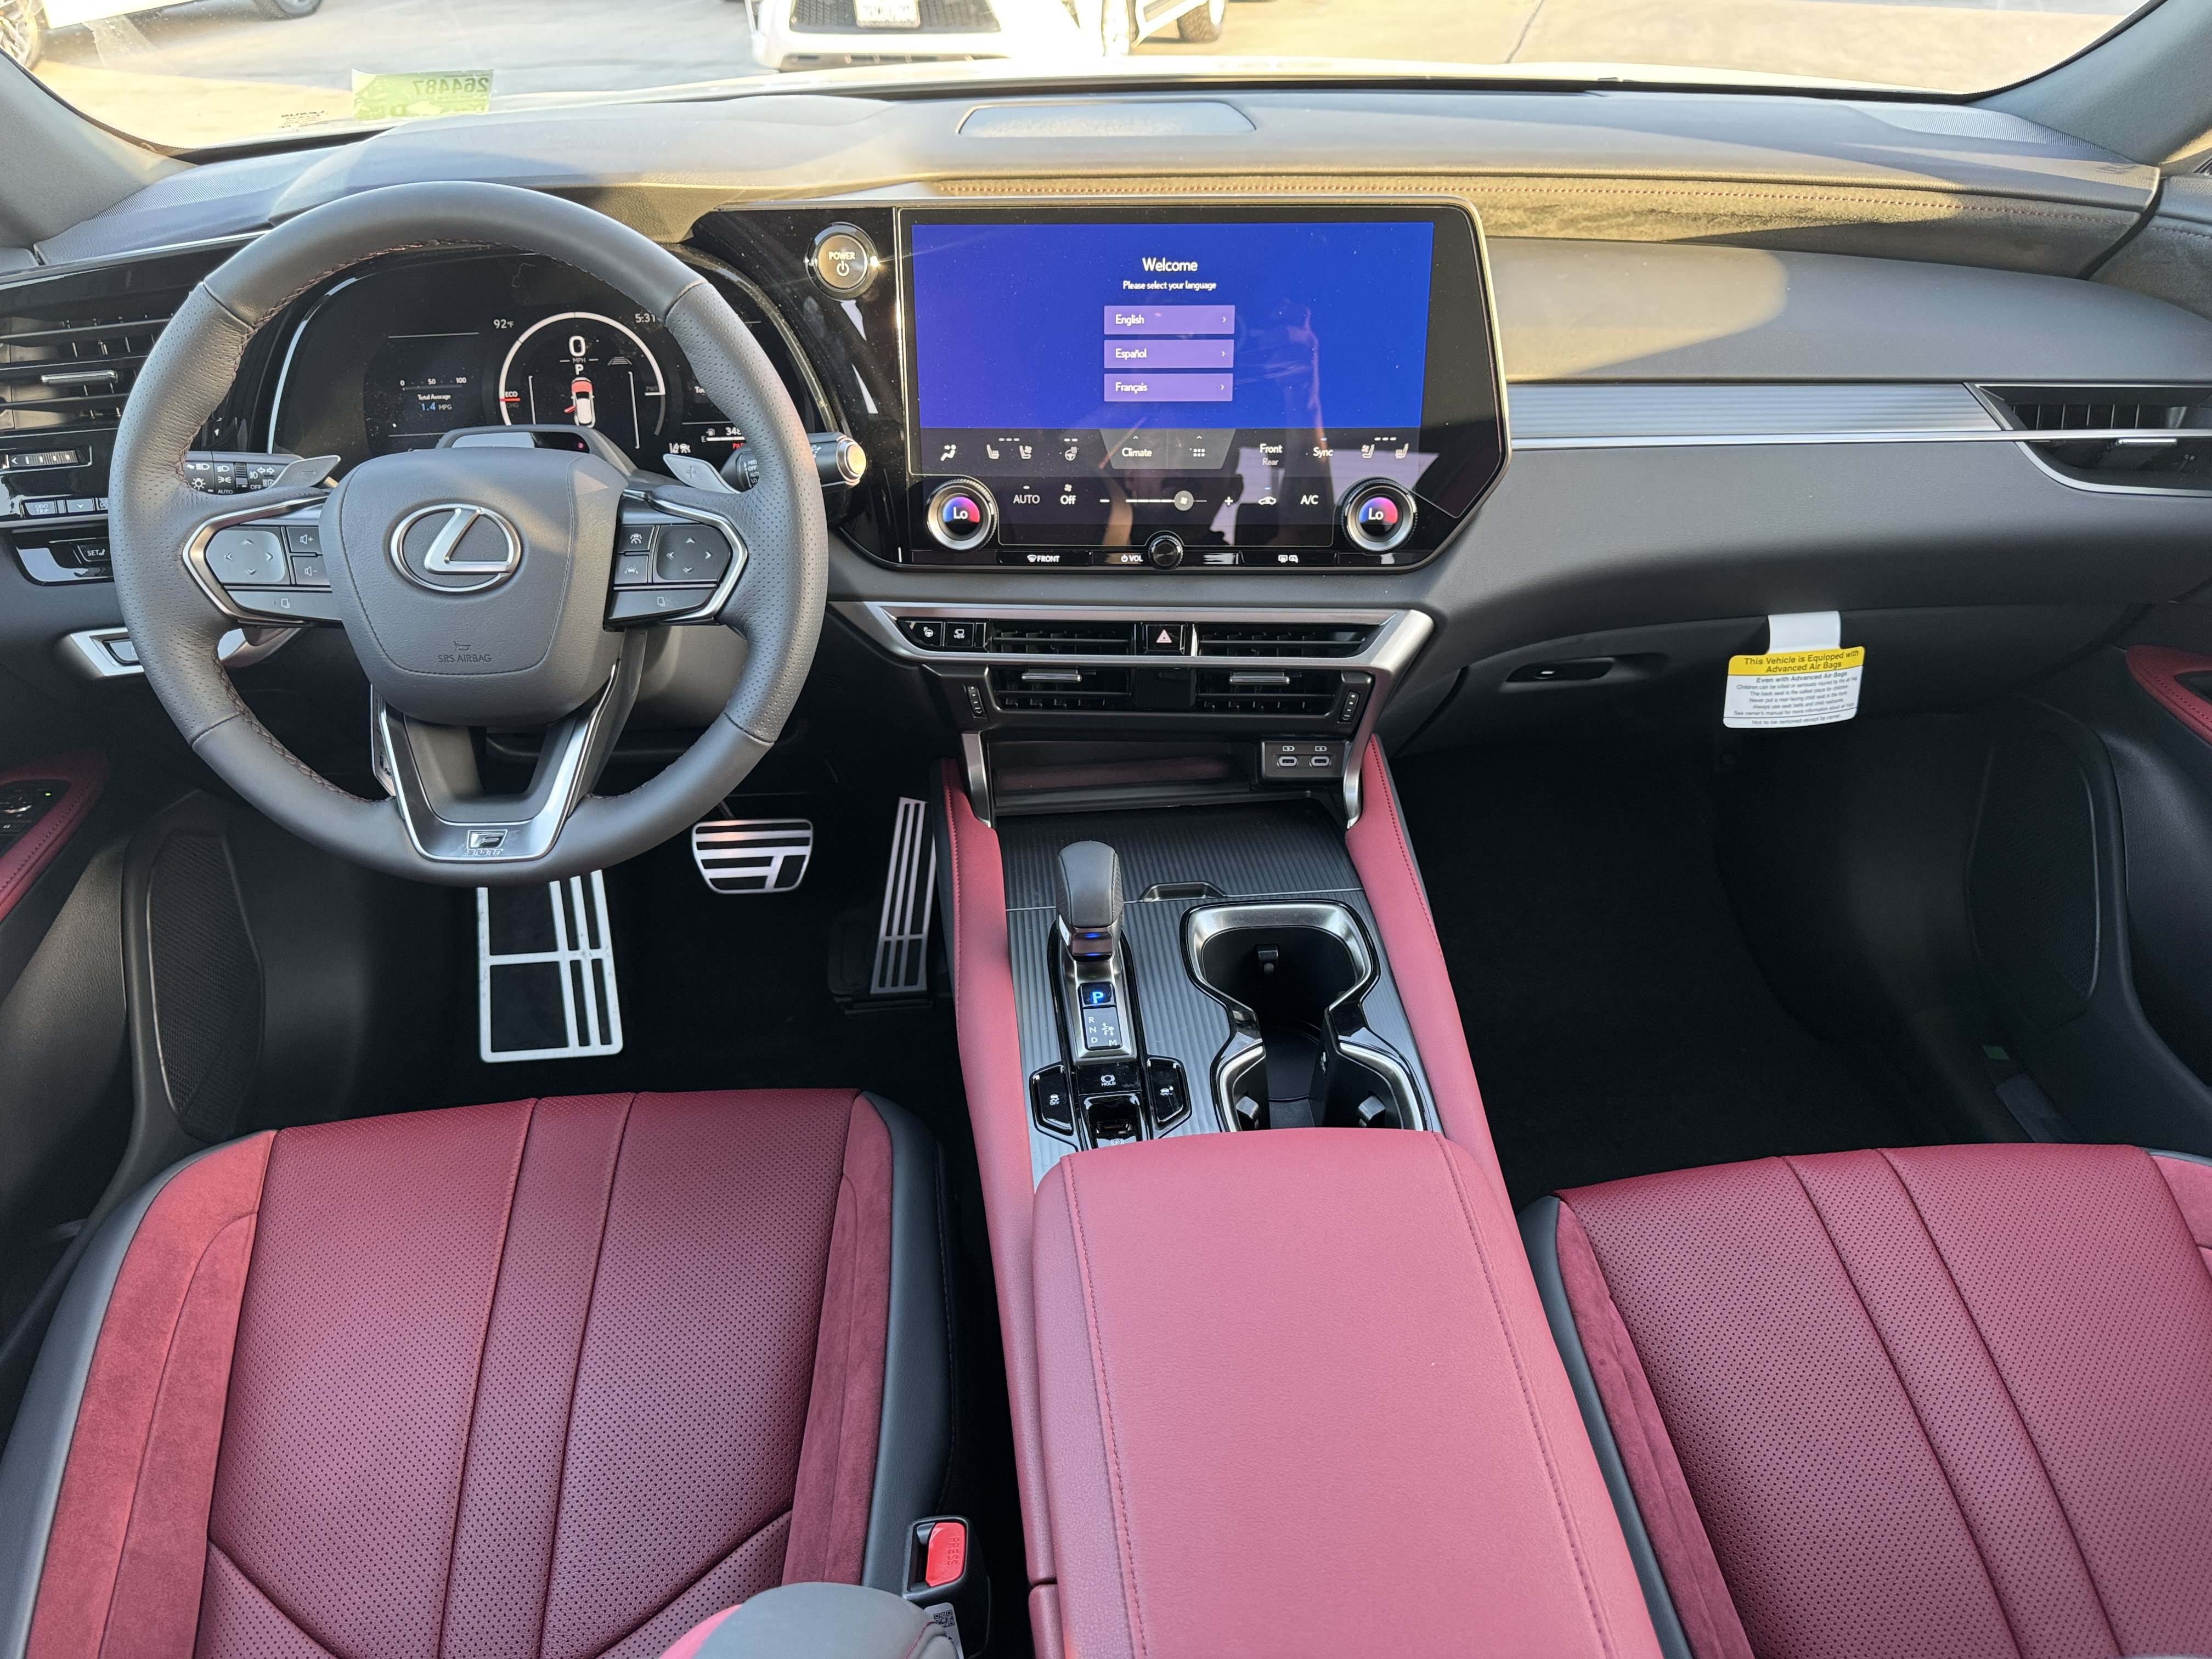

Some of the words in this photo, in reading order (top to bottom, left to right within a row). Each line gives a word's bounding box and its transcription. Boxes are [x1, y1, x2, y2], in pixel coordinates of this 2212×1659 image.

[828, 251, 855, 260] POWER
[1142, 257, 1198, 272] Welcome
[1123, 280, 1146, 290] Please
[1147, 280, 1167, 290] select
[1169, 282, 1184, 291] your
[1185, 280, 1217, 291] language
[635, 313, 656, 324] 5:31
[1115, 314, 1145, 326] English
[568, 335, 586, 357] 0
[1115, 348, 1147, 360] Español
[575, 364, 584, 375] P
[1115, 382, 1148, 394] Français
[421, 403, 436, 411] 1.4
[1121, 448, 1153, 458] Climate
[1260, 443, 1283, 454] Front
[1313, 447, 1334, 459] Sync
[1262, 458, 1279, 466] Rear
[1013, 495, 1040, 504] AUTO
[1060, 495, 1076, 505] Off
[1300, 495, 1319, 505] A/C
[953, 507, 968, 520] Lo
[1368, 508, 1384, 520] Lo
[438, 654, 455, 663] SRS
[458, 654, 492, 663] AIRBAG
[1808, 652, 1844, 663] Equipped
[1846, 650, 1859, 658] with
[1765, 663, 1807, 673] Advanced
[1823, 662, 1842, 670] Bags
[1092, 991, 1104, 1004] P
[947, 1537, 960, 1565] PRESS
